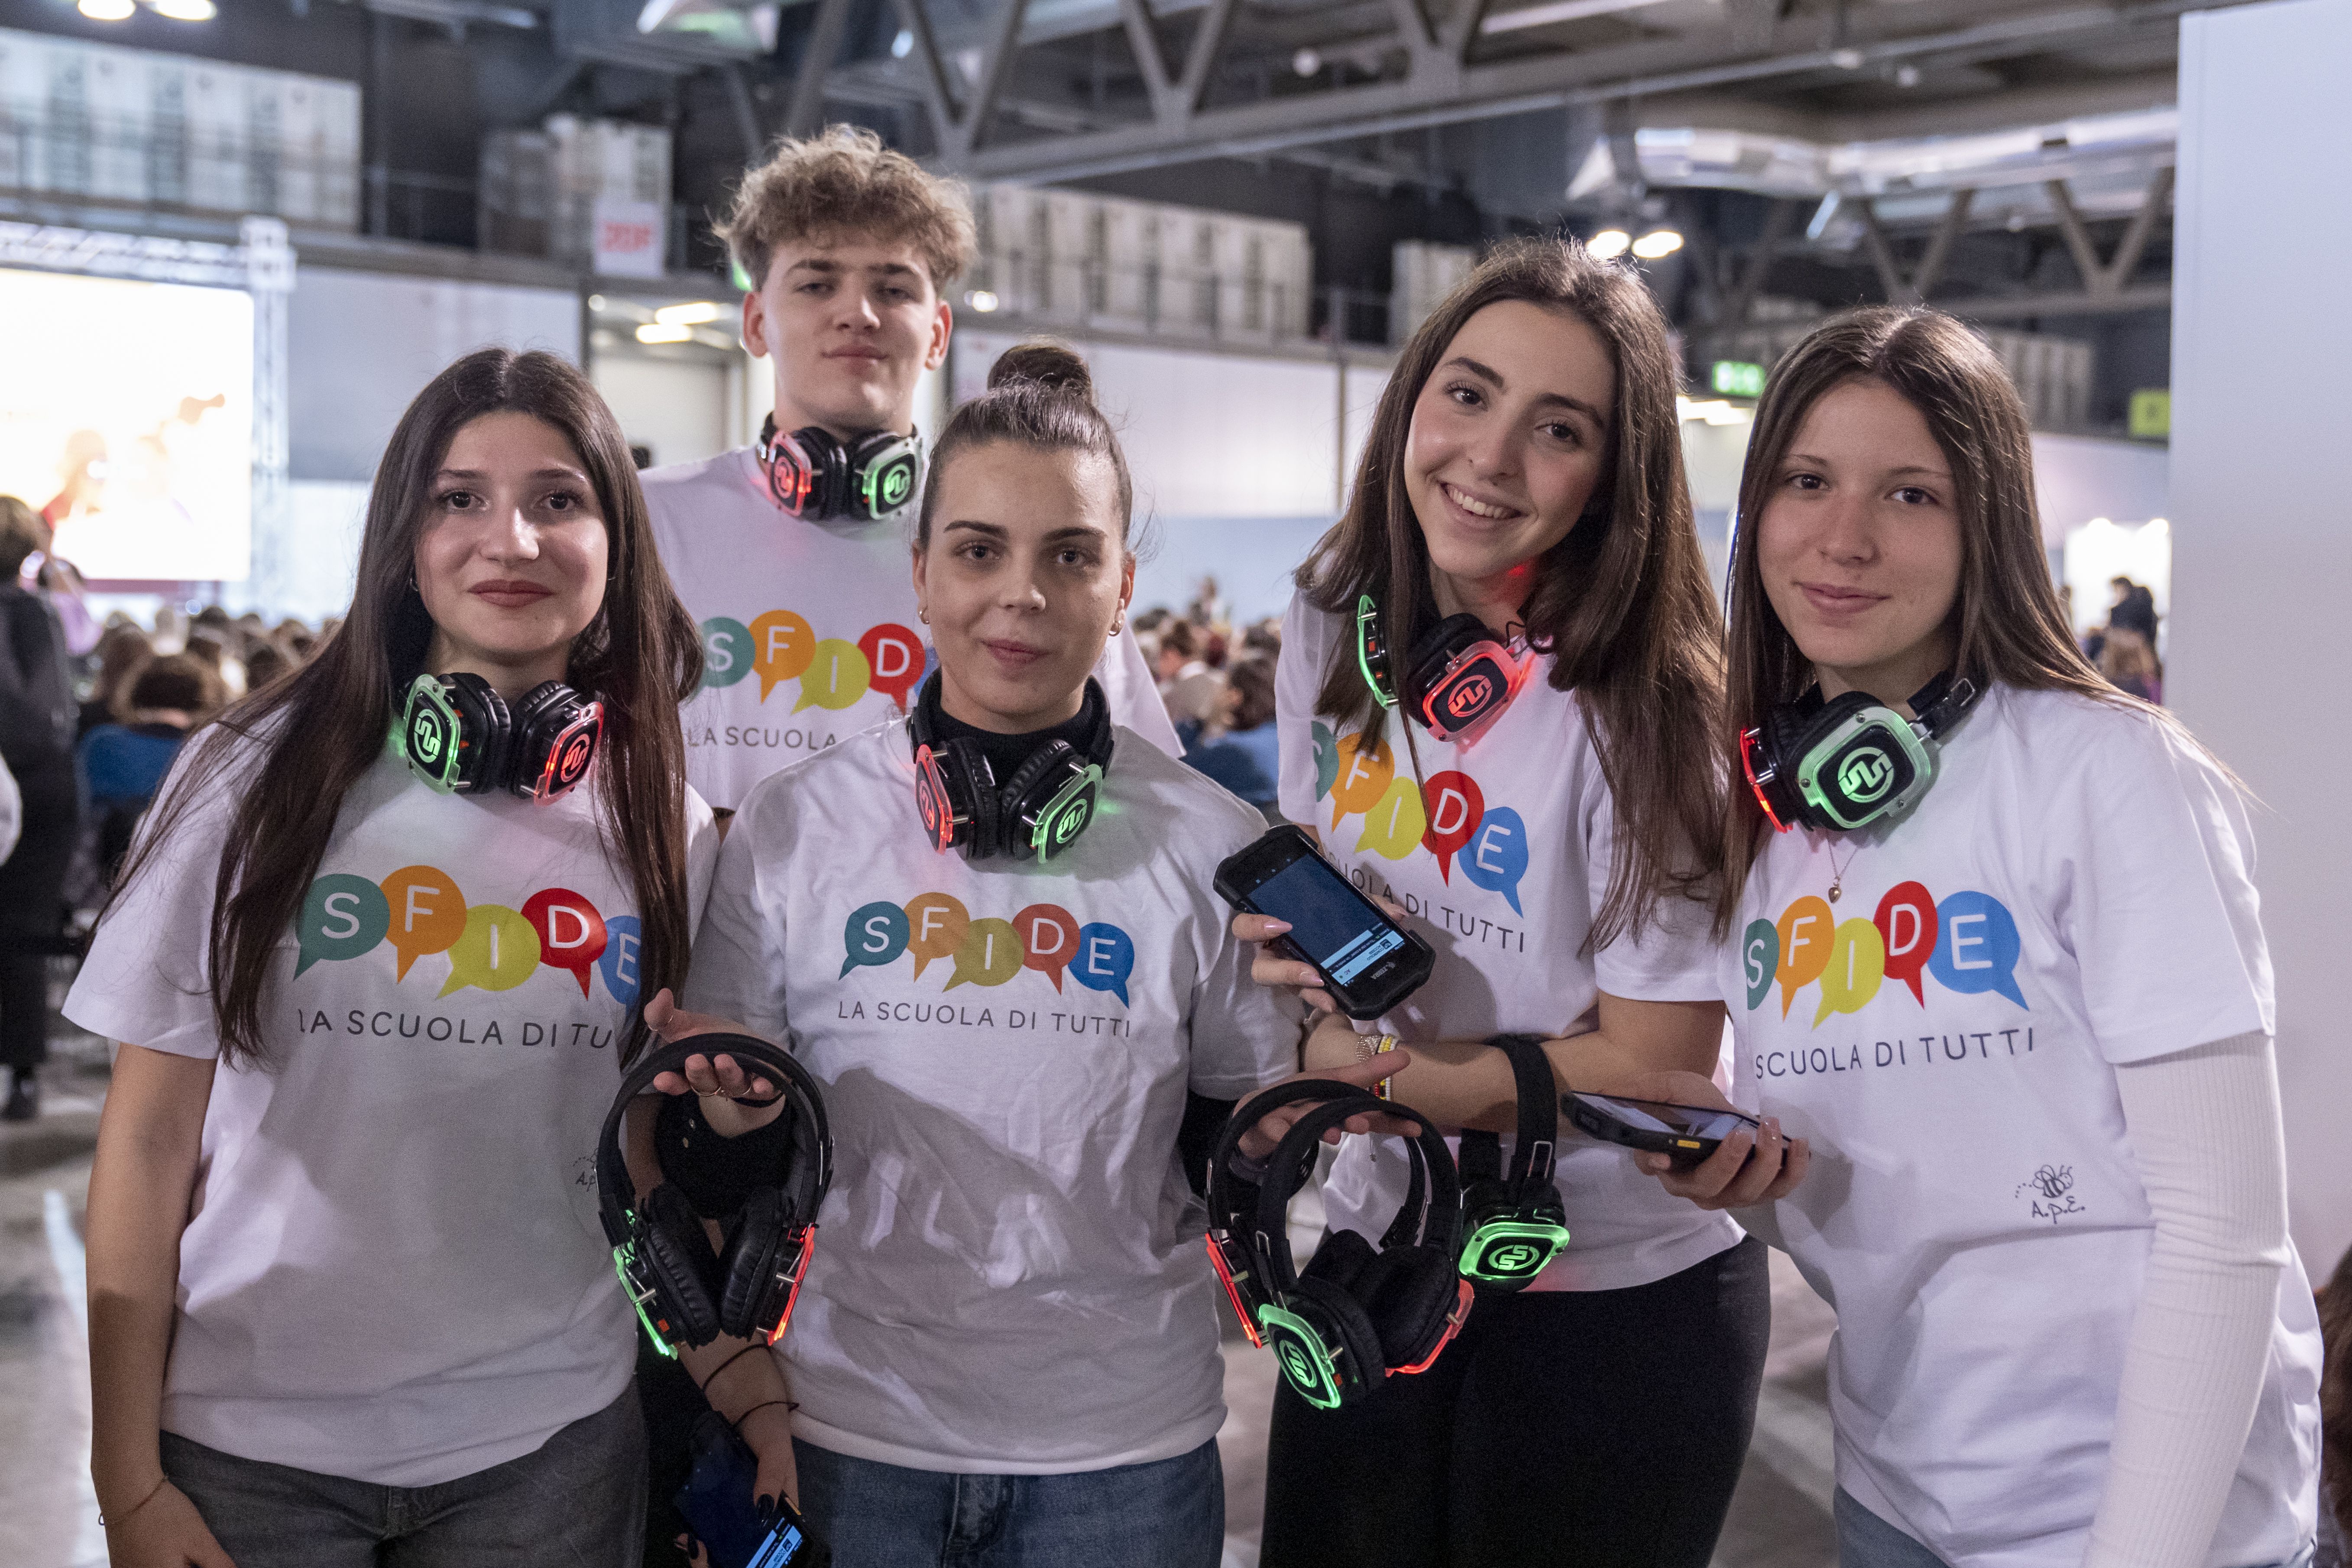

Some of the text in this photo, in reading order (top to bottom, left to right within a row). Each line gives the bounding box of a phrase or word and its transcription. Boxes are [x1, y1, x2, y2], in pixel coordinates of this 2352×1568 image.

[705, 623, 912, 695] SFID
[725, 726, 836, 751] SCUOLA
[320, 883, 641, 986] SFIDE
[860, 904, 1118, 978] SFIDE
[1405, 893, 1428, 920] DI
[1440, 906, 1524, 953] TUTTI
[1745, 901, 1994, 991] SFIDE
[347, 1009, 503, 1046] SCUOLA
[522, 1022, 557, 1047] DI
[838, 1001, 1130, 1038] LA SCUOLA DI TUTTI
[1756, 1027, 2034, 1079] SCUOLA DI TUTTI
